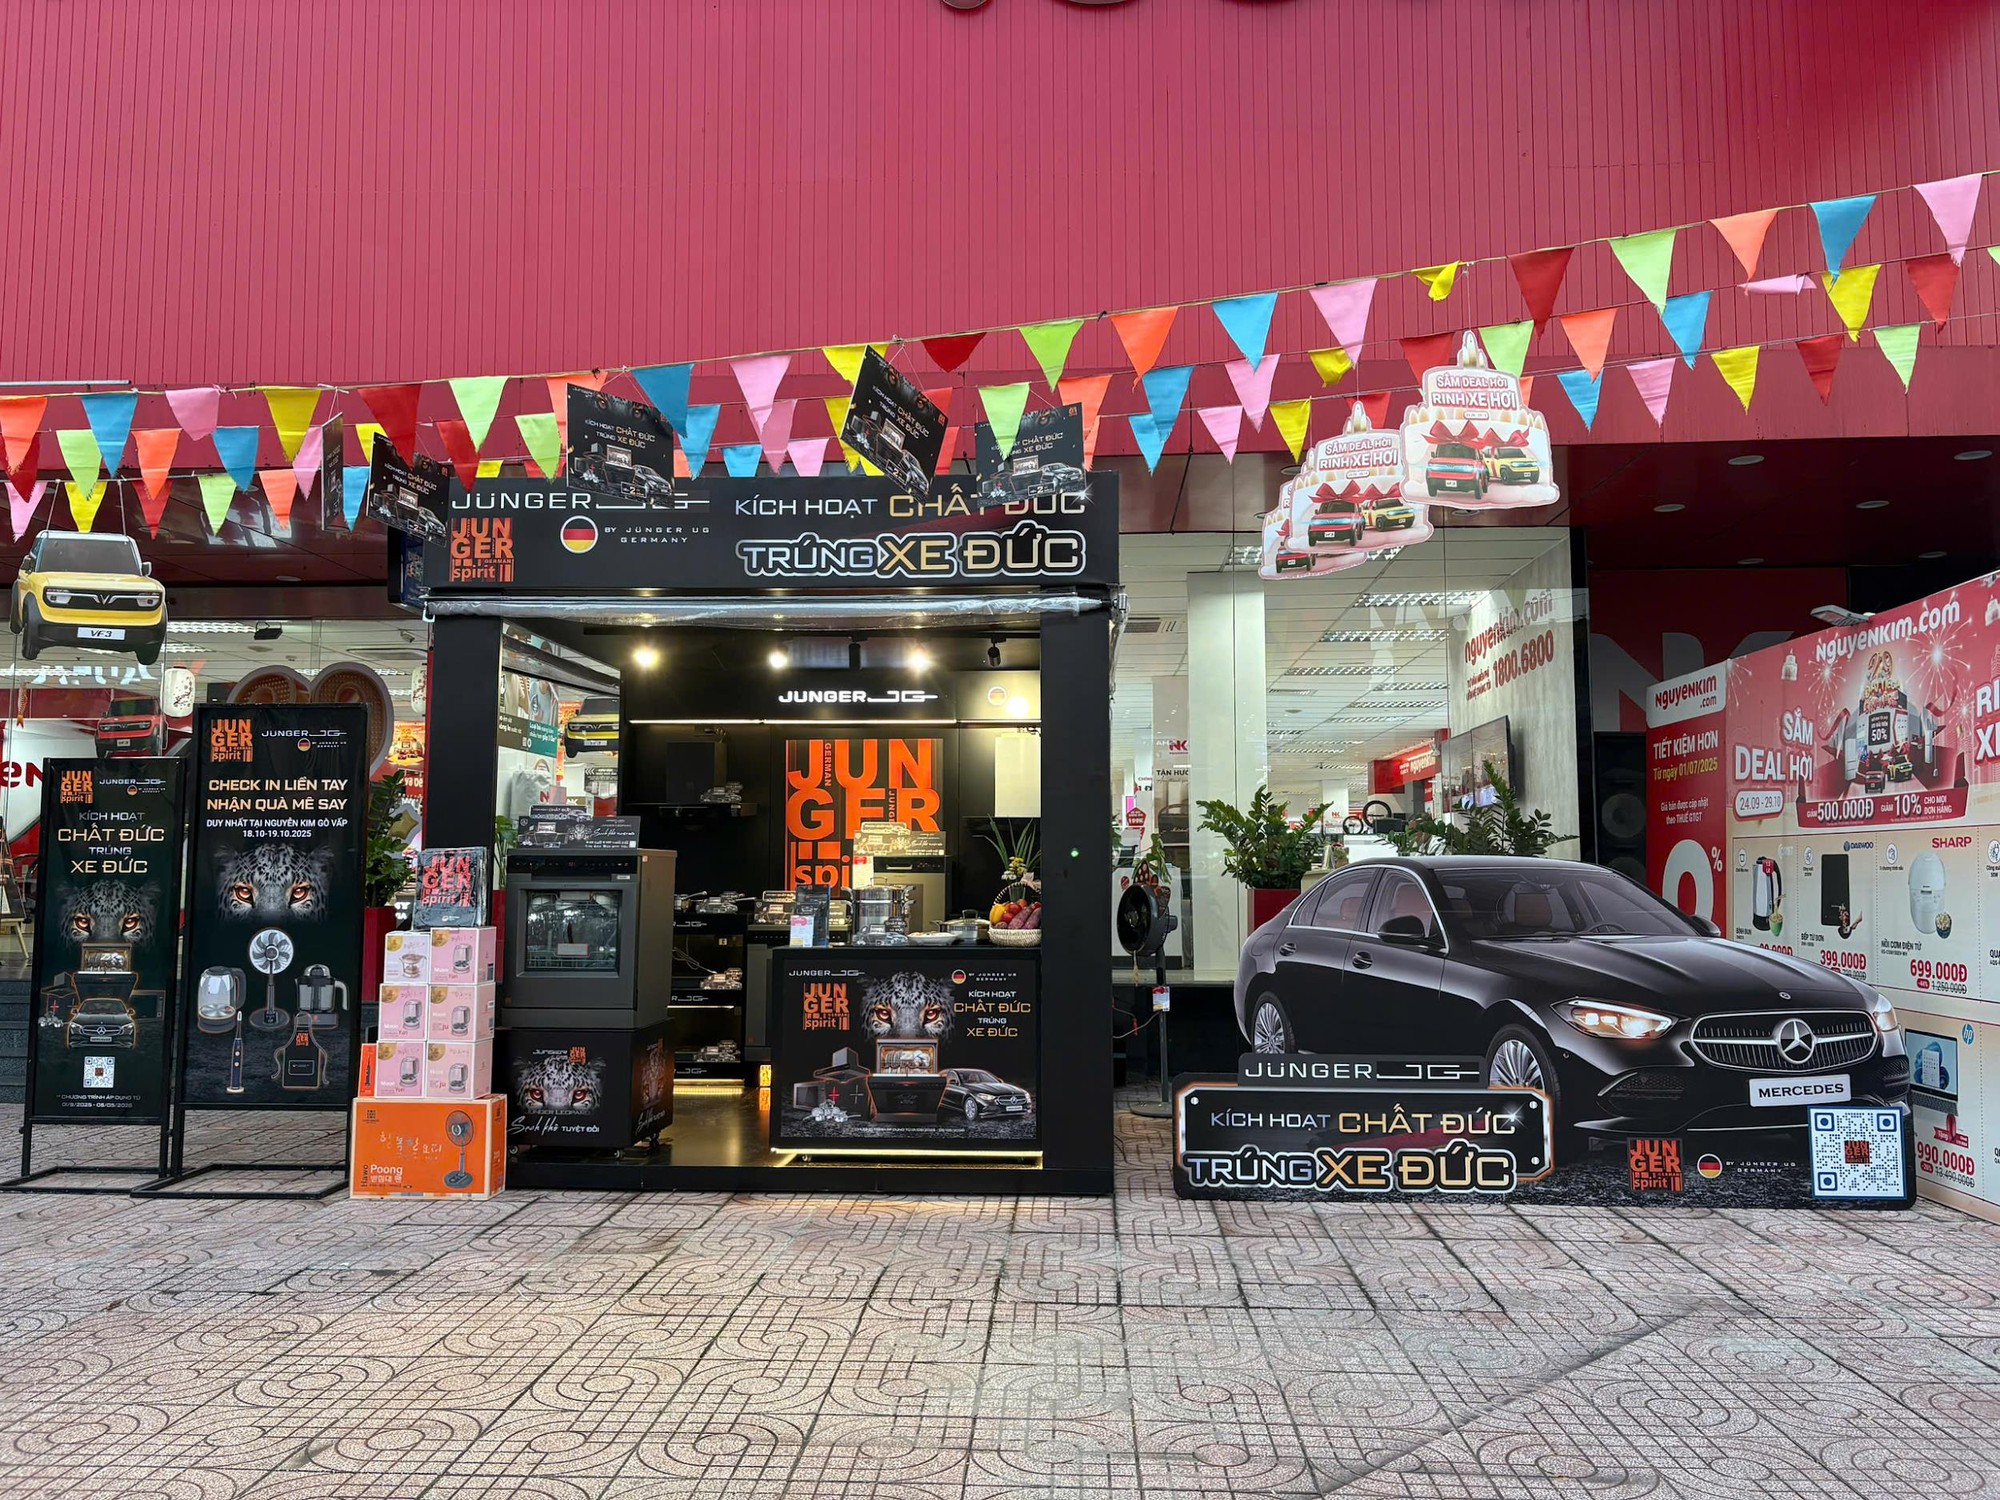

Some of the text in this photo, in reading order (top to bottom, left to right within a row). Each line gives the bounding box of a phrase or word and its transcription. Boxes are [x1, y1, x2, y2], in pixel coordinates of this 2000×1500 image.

[1438, 373, 1508, 388] SẮM DEAL HỜI
[1432, 391, 1516, 409] RINH XE HƠI
[617, 436, 628, 444] XE
[1326, 440, 1347, 454] SẮM
[1349, 441, 1373, 452] DEAL
[1023, 446, 1034, 454] XE
[1320, 449, 1398, 469] RINH XE HƠI
[735, 493, 797, 516] KÍCH
[805, 499, 878, 519] HOẠT
[452, 518, 512, 539] JUN
[626, 526, 683, 534] JÜNGER
[452, 538, 514, 559] GER
[743, 527, 1079, 571] TRÚNG XE ĐỨC
[453, 565, 496, 582] spirit
[1493, 629, 1554, 689] 1800.6800
[211, 719, 251, 733] JUN
[211, 732, 253, 747] GER
[1871, 729, 1888, 742] 50%
[1653, 730, 1719, 760] TIẾT KIỆM HƠN
[212, 751, 242, 762] spirit
[1735, 745, 1786, 781] DEAL
[787, 739, 933, 790] JUN
[823, 742, 832, 787] GERMAN
[1678, 757, 1719, 776] 01/07/2025
[61, 770, 92, 781] JUN
[61, 780, 93, 792] GER
[208, 776, 348, 791] CHECK IN LIỀN TAY
[206, 797, 348, 812] NHẬN QUÀ MÊ SAY
[1817, 799, 1874, 821] 500.000Đ
[1894, 794, 1922, 817] 10%
[79, 810, 145, 822] KÍCH HOẠT
[206, 819, 224, 828] DUY
[224, 816, 248, 827] NHẤT
[250, 819, 263, 829] TẠI
[300, 819, 316, 827] KIM
[317, 817, 330, 827] GÒ
[331, 816, 348, 827] VẤP
[57, 822, 165, 842] CHẤT ĐỨC
[242, 830, 312, 838] 18.10-19.10.2025
[88, 844, 132, 855] TRÚNG
[1850, 841, 1874, 850] DAEWOO
[1931, 836, 1972, 849] SHARP
[70, 856, 148, 874] XE ĐỨC
[421, 894, 457, 907] spirit
[1820, 950, 1867, 971] 399.000Đ
[1910, 959, 1968, 983] 699.000Đ
[803, 983, 848, 999] JUN
[968, 989, 1017, 999] KÍCH HOẠT
[803, 998, 850, 1013] GER
[953, 998, 1032, 1013] CHẤT ĐỨC
[805, 1017, 837, 1031] spirit
[977, 1016, 1007, 1024] TRÚNG
[966, 1025, 1018, 1037] XE ĐỨC
[1963, 1024, 1975, 1043] hp
[1758, 1083, 1844, 1099] MERCEDES
[1210, 1103, 1517, 1135] KÍCH HOẠT CHẤT ĐỨC
[561, 1125, 586, 1134] TUYỆT
[1630, 1139, 1677, 1157] JUN
[370, 1164, 403, 1176] Poong
[1187, 1145, 1510, 1186] TRÚNG XE ĐỨC
[1630, 1155, 1682, 1173] GER
[1632, 1177, 1668, 1191] spirit
